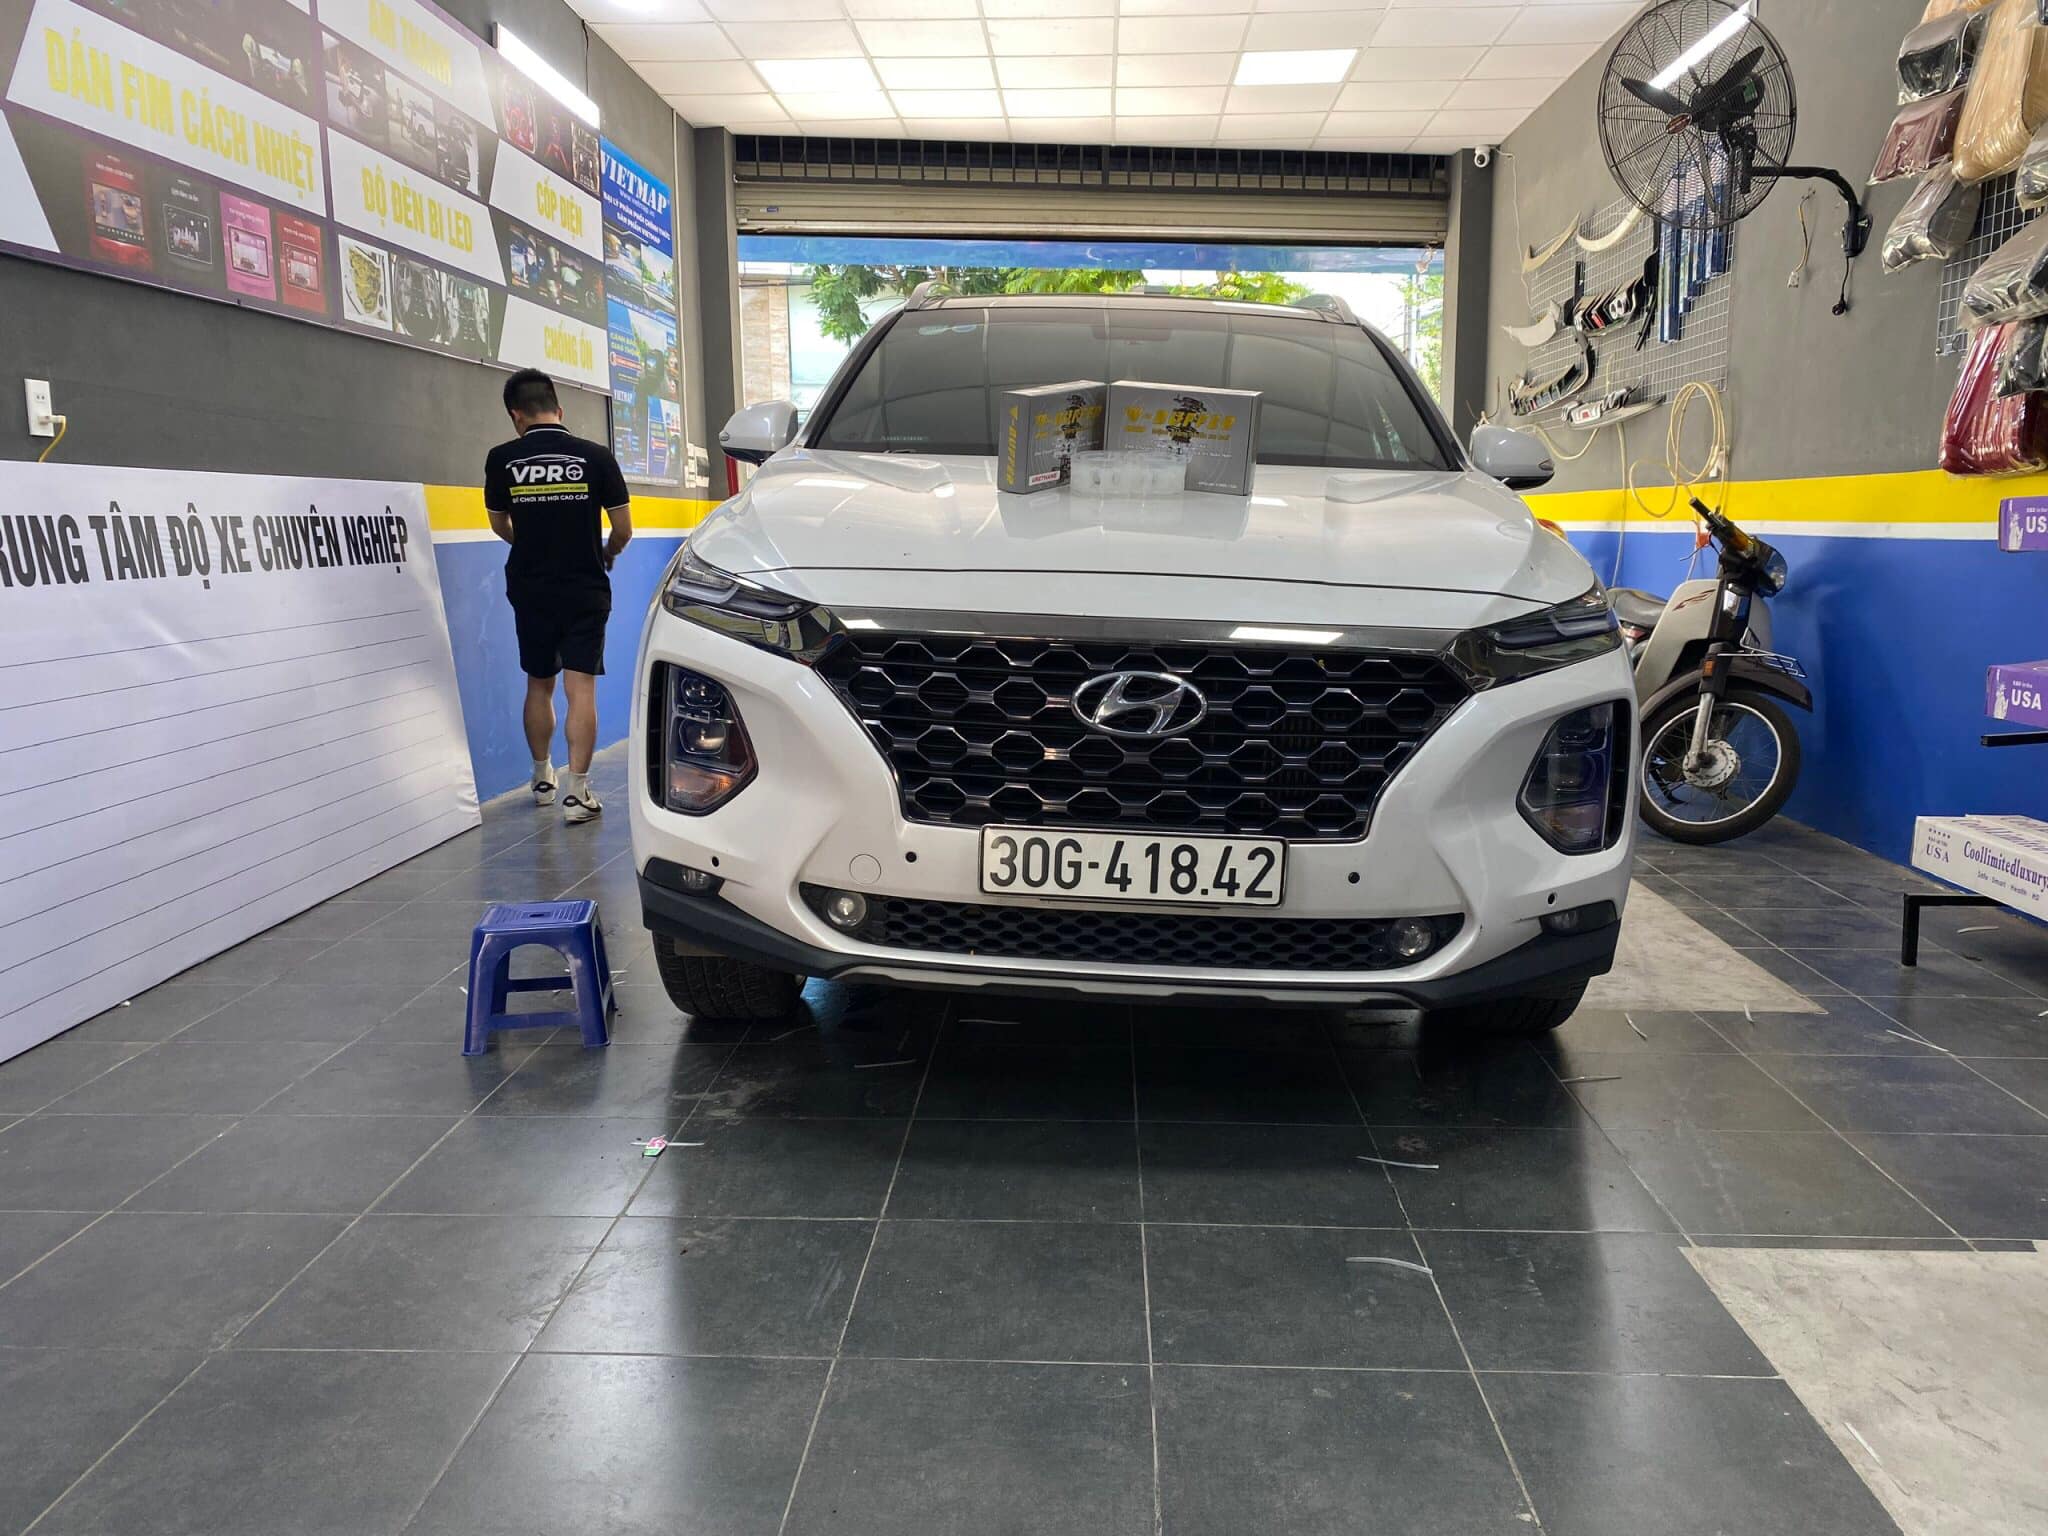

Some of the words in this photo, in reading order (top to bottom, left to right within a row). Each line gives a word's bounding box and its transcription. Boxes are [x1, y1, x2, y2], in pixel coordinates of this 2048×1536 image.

[120, 59, 175, 136] FIM
[180, 86, 250, 166] CÁCH
[600, 149, 667, 214] VIETMAP
[428, 197, 444, 242] BI
[447, 208, 473, 253] LED
[87, 501, 167, 581] TÂM
[165, 503, 210, 589] ĐỘ
[211, 515, 252, 574] XE
[252, 505, 344, 571] CHUYÊN
[343, 506, 408, 574] NGHIỆP
[2026, 515, 2048, 533] US
[2011, 688, 2042, 711] USA
[990, 835, 1276, 898] 30G-418.42
[1926, 842, 1950, 864] USA
[1963, 840, 2048, 893] Coollimitedluxury
